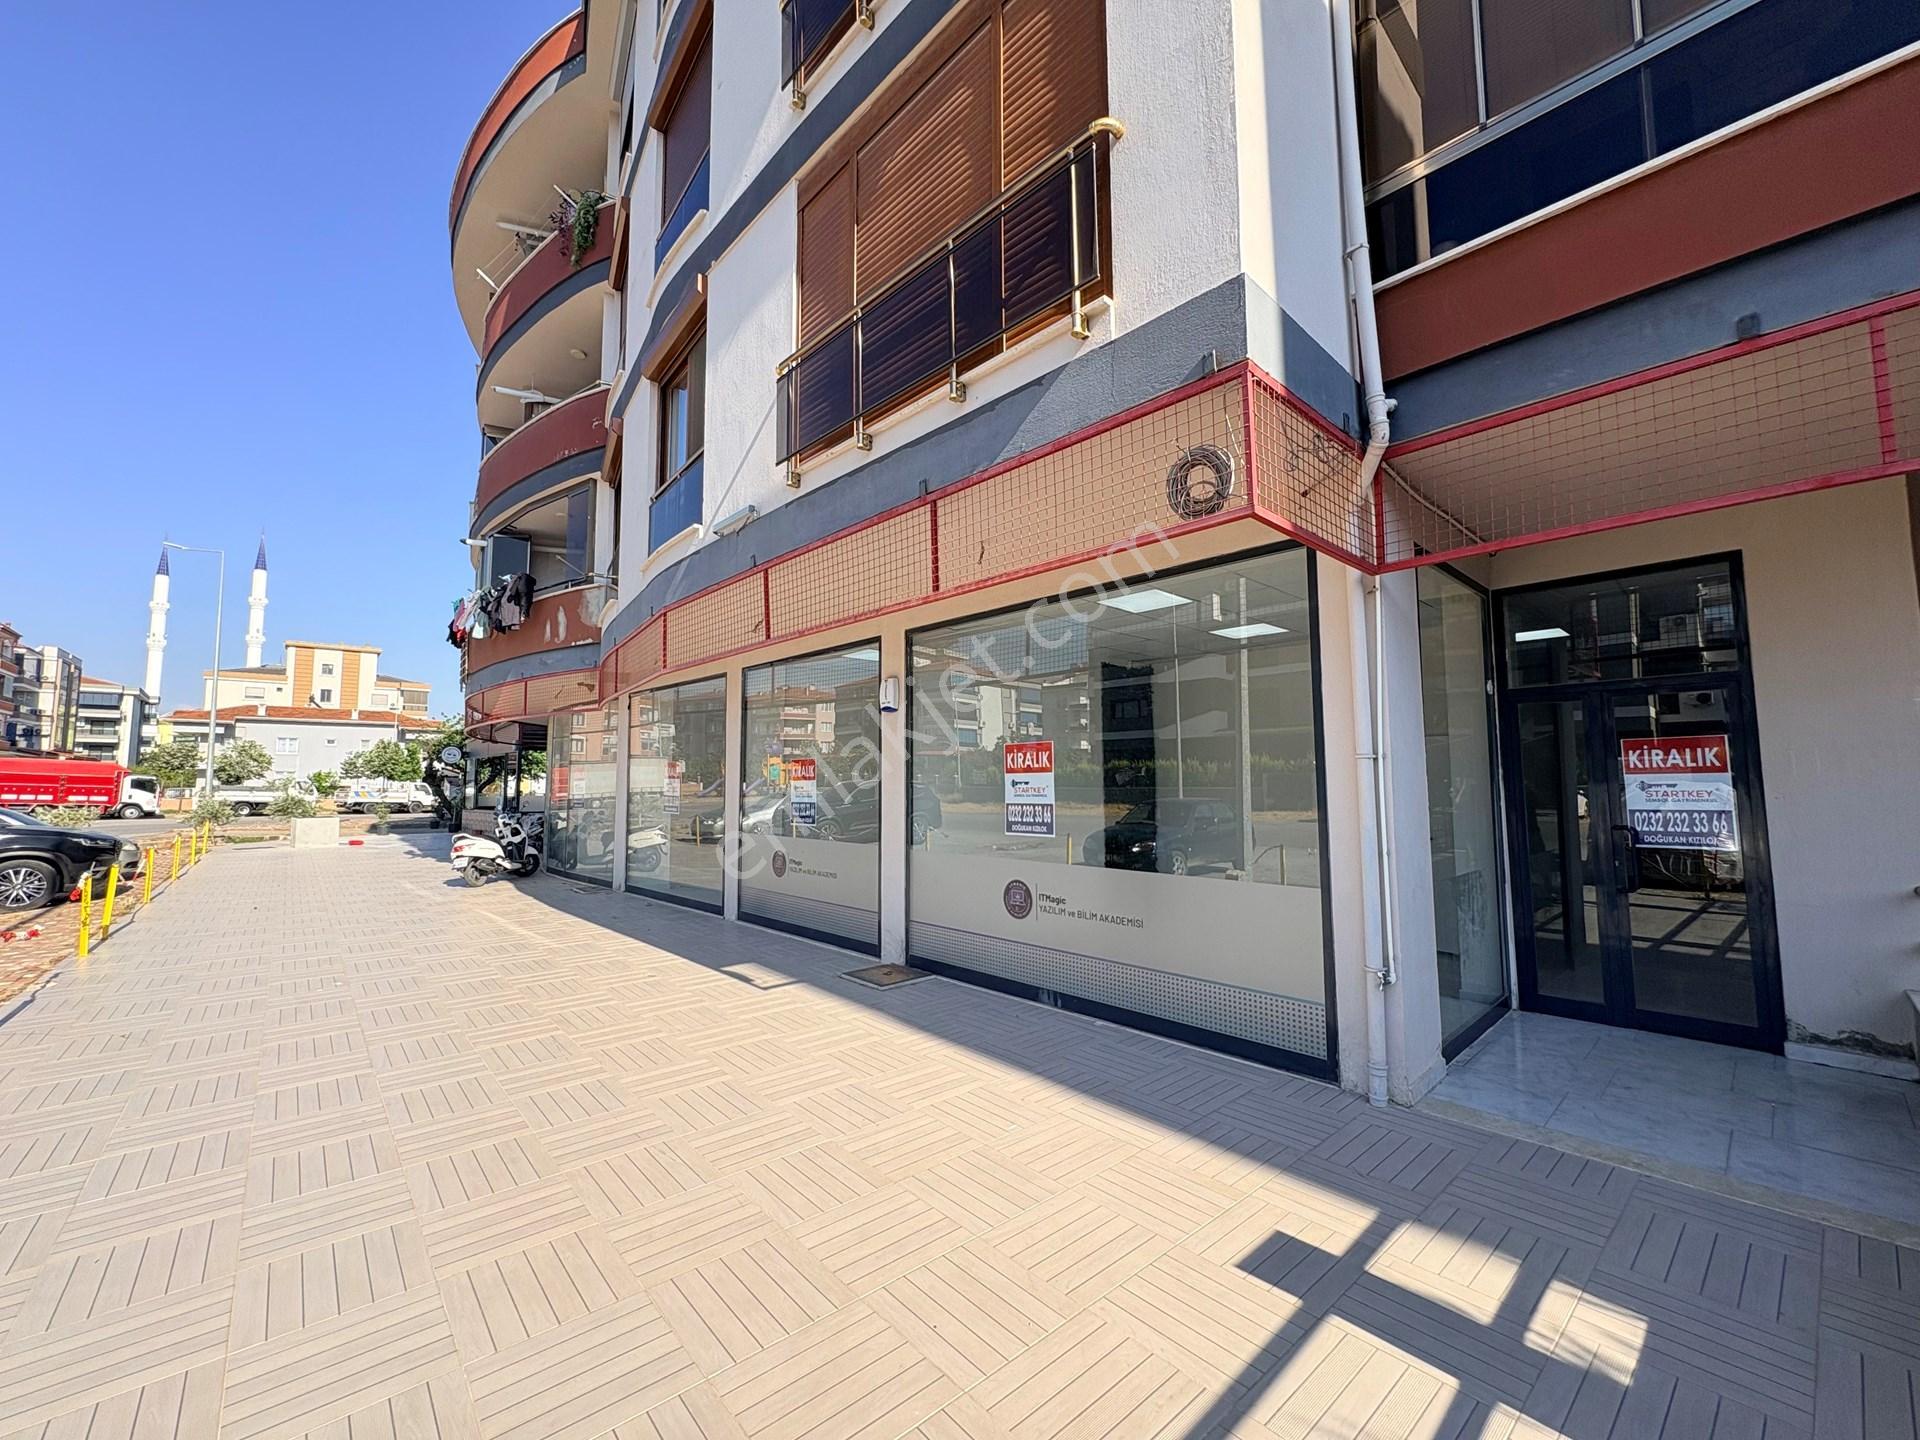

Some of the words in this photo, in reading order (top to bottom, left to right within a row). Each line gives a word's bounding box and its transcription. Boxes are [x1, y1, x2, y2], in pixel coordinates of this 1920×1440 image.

[1007, 748, 1051, 769] KİRALIK
[1628, 745, 1721, 769] KİRALIK
[1645, 790, 1713, 798] STARTKEY
[1008, 805, 1022, 822] 0232
[1023, 805, 1034, 822] 232
[1035, 806, 1042, 823] 33
[1044, 806, 1051, 823] 66
[1634, 812, 1663, 832] 0232
[1667, 812, 1690, 832] 232
[1692, 813, 1709, 833] 33
[1712, 813, 1728, 833] 66
[1644, 834, 1686, 844] DOĞUKAN
[1039, 893, 1066, 906] ITMagic
[1039, 904, 1066, 916] YAZILIM
[1067, 910, 1076, 918] ve
[1077, 908, 1098, 921] BİLİM
